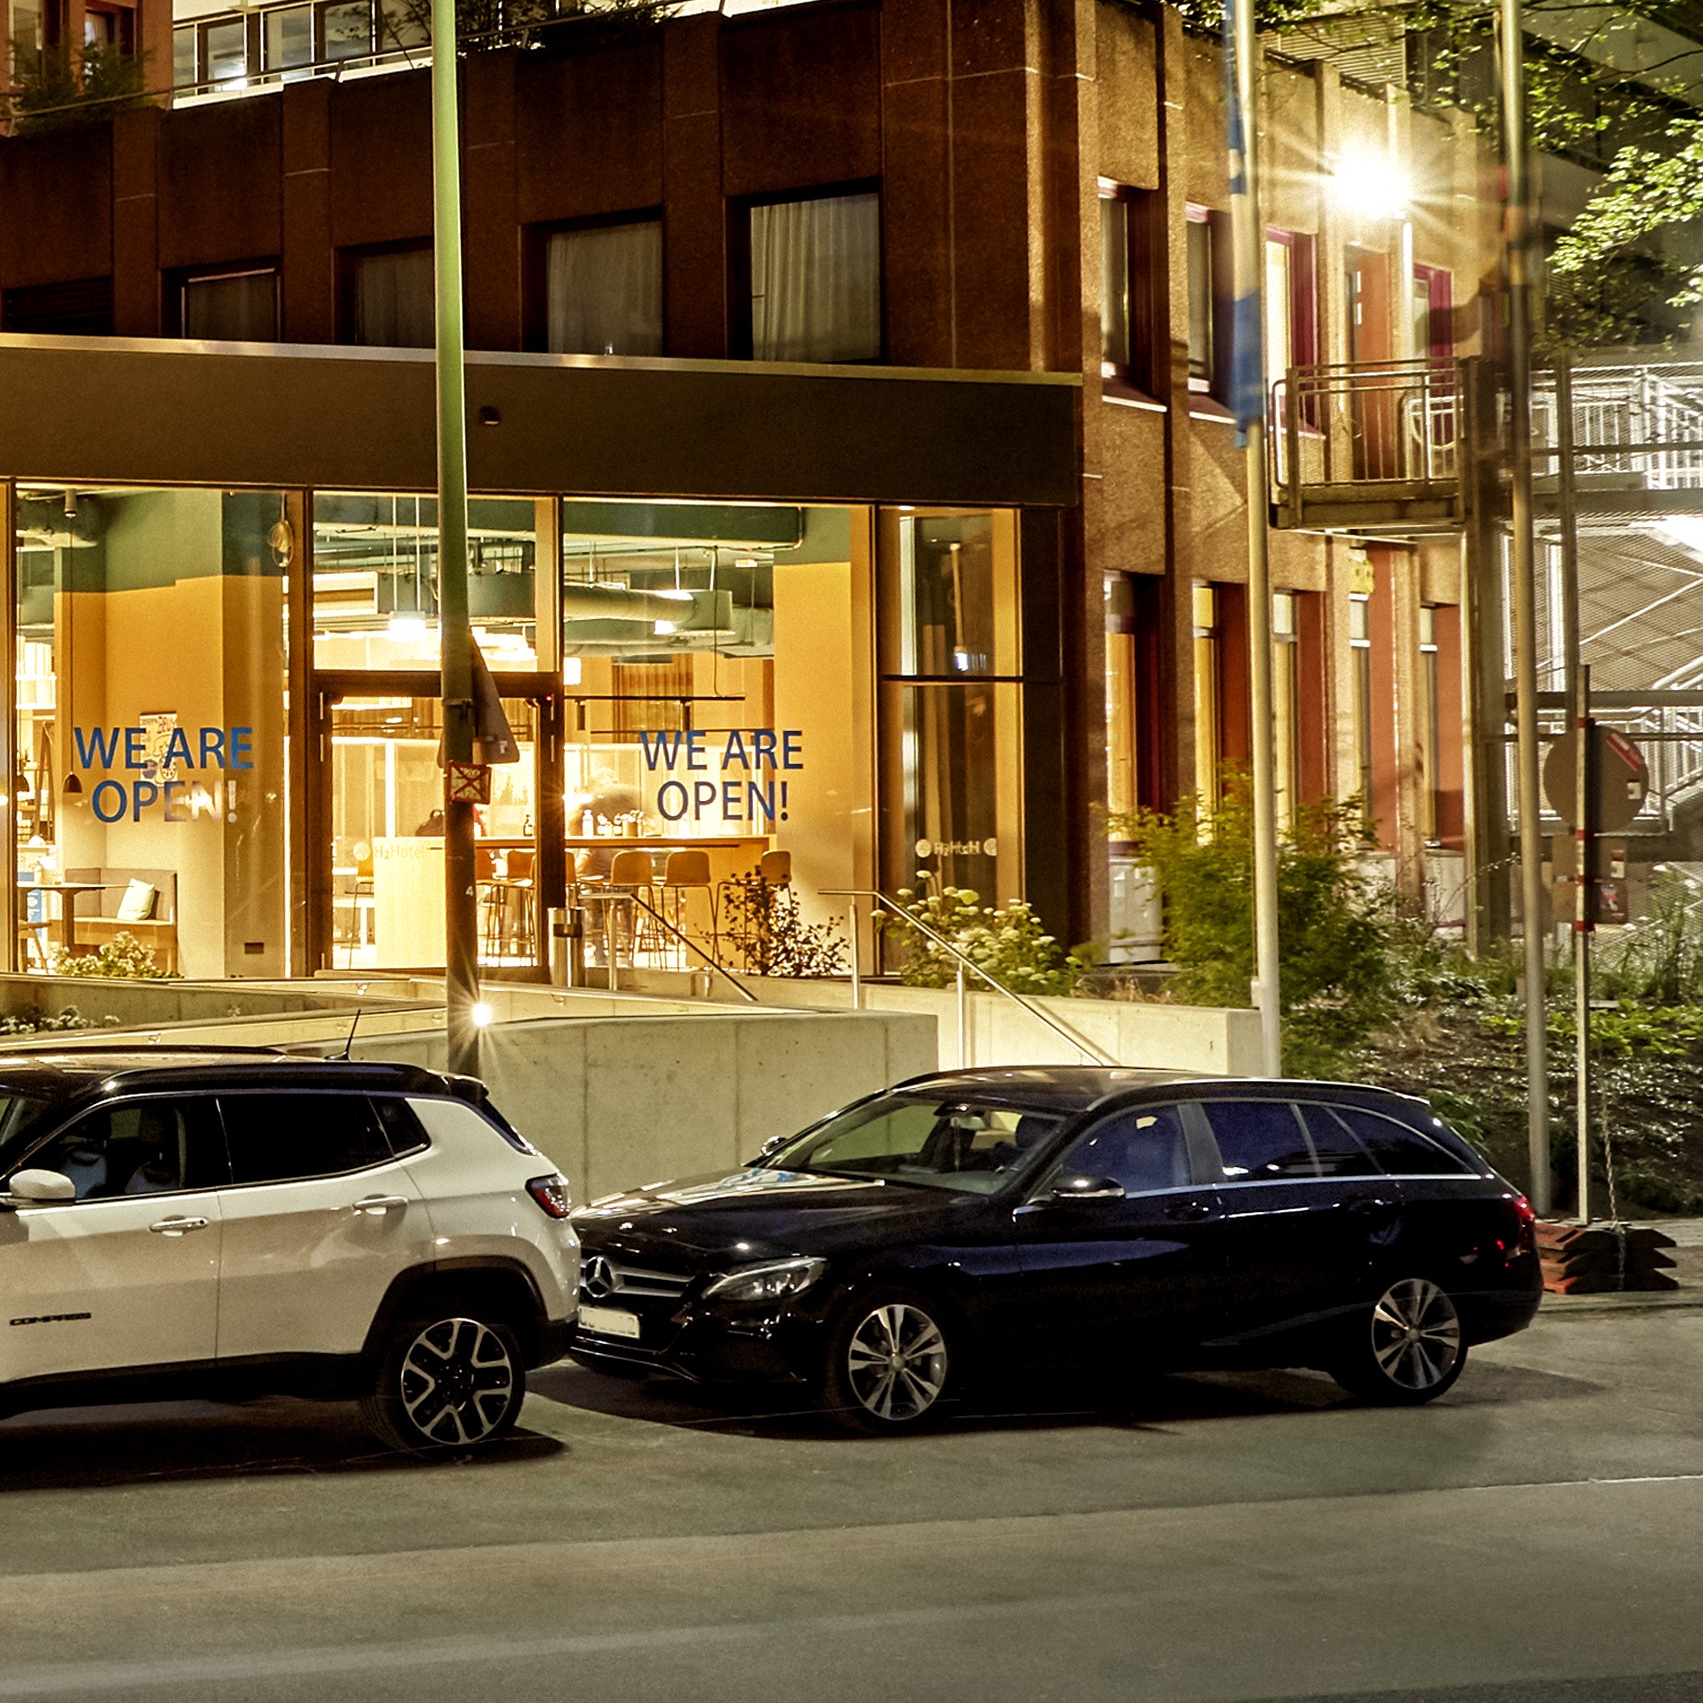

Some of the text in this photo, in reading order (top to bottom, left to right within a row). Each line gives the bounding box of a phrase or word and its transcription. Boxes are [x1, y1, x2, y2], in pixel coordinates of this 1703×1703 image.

[74, 727, 254, 770] WE ARE
[640, 730, 804, 771] WE ARE
[92, 780, 237, 824] OPEN!
[657, 780, 788, 821] OPEN!
